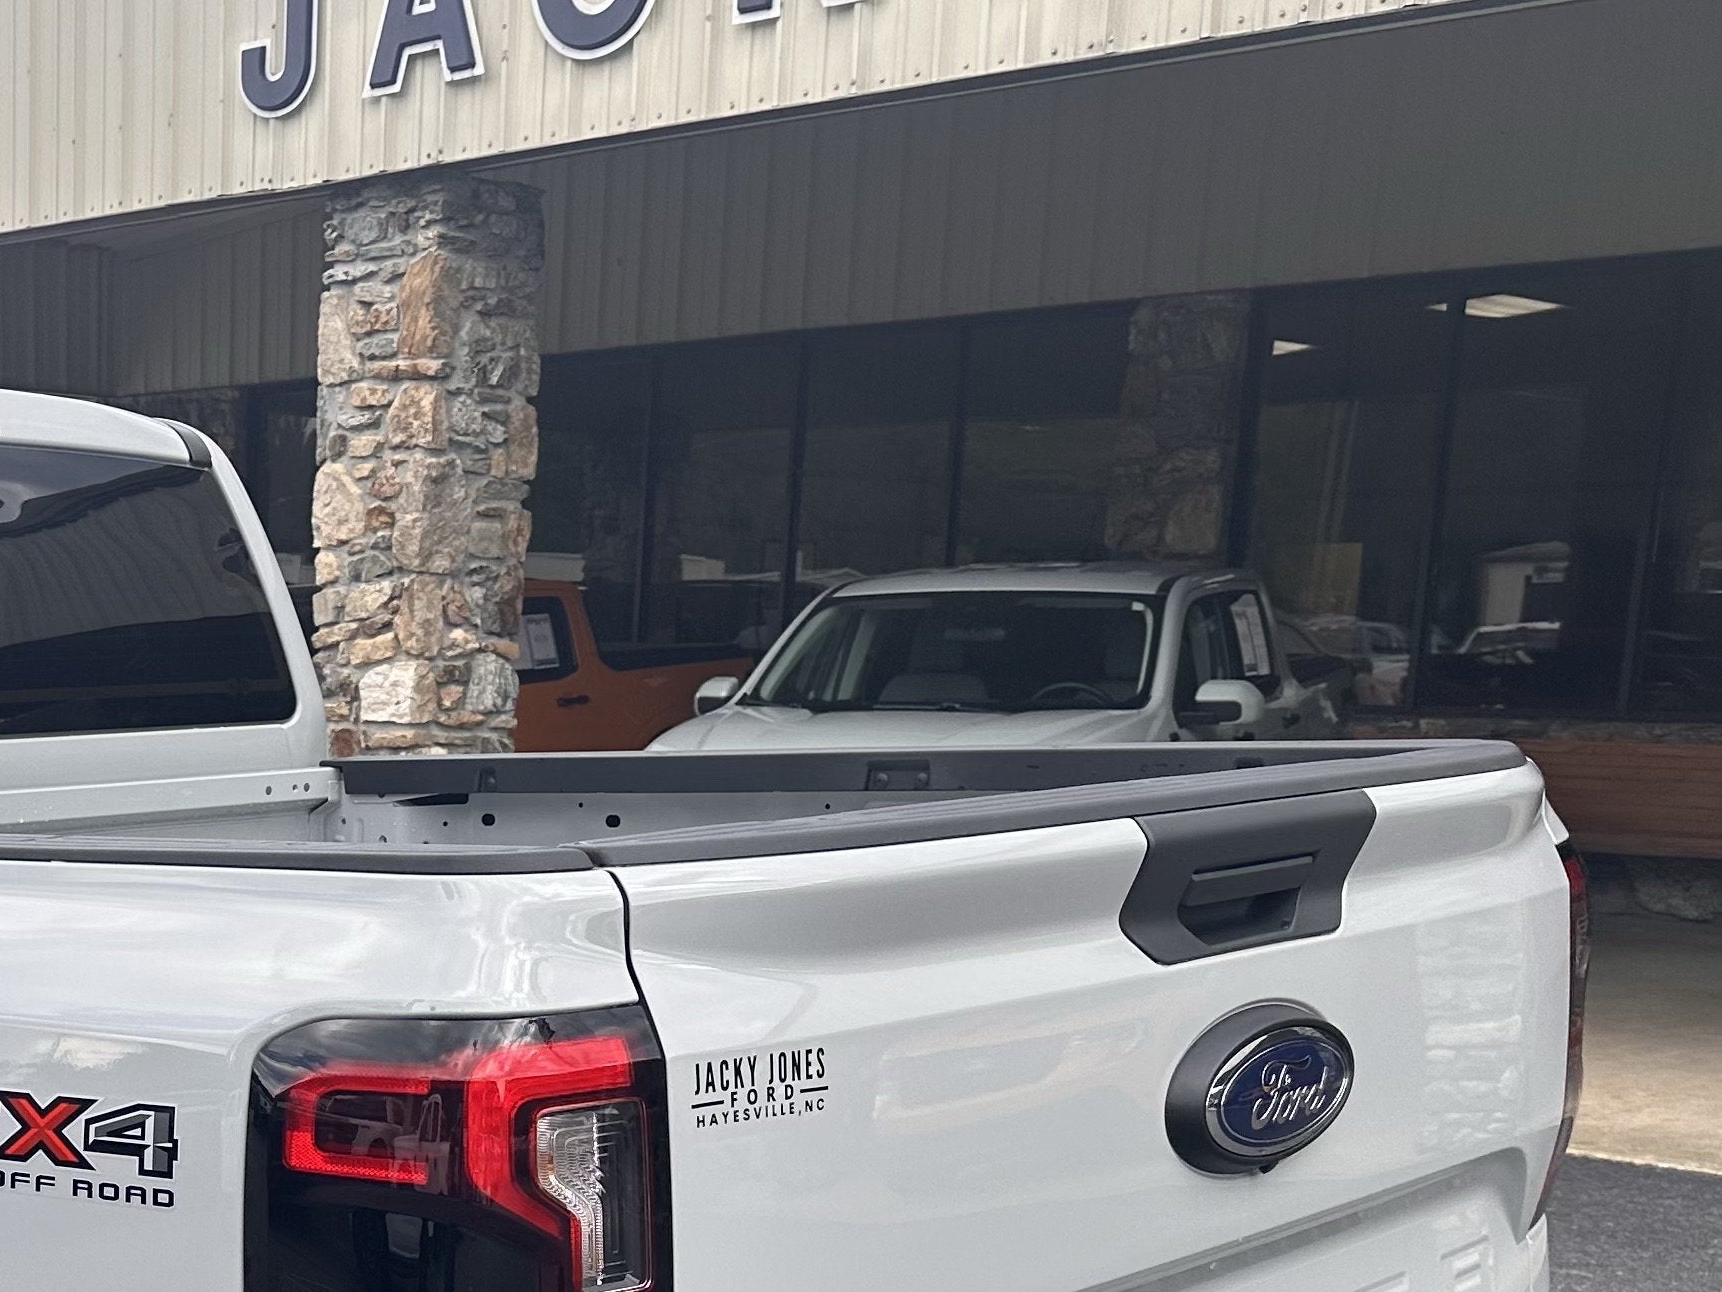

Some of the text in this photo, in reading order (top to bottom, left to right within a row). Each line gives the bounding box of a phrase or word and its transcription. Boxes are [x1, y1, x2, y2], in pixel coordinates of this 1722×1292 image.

[694, 1047, 825, 1096] JACKY JONES
[730, 1084, 794, 1108] FORD
[72, 1178, 175, 1208] ROAD
